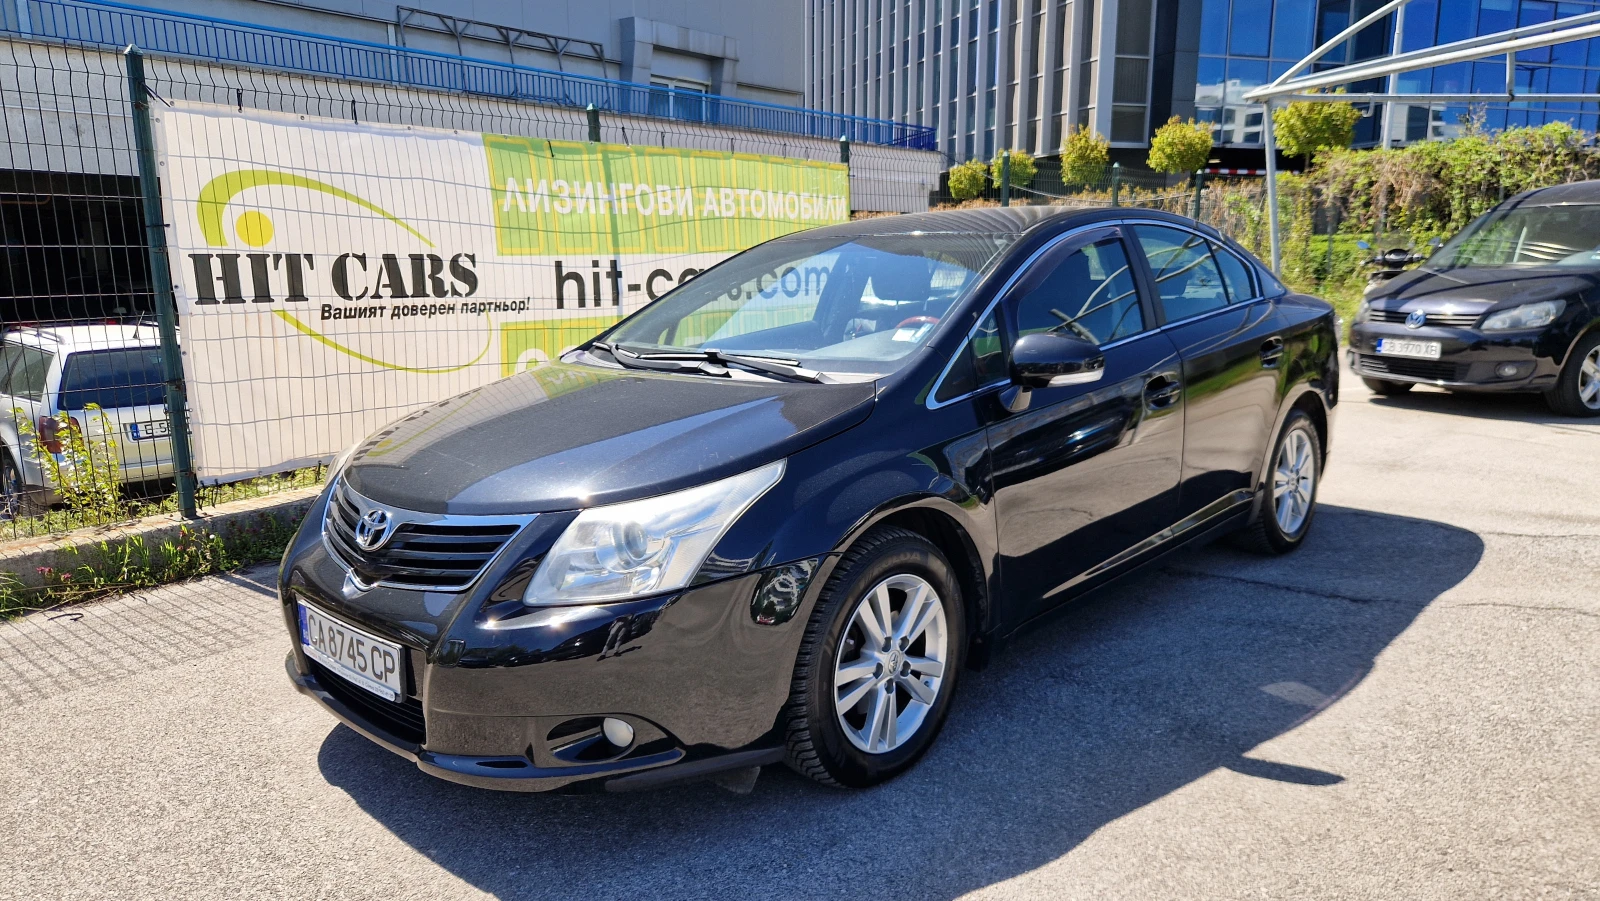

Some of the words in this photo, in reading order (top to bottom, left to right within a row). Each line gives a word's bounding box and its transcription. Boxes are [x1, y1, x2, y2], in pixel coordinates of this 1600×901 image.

[503, 177, 693, 217] ЛИЗИНГОВИ
[703, 186, 847, 221] АВТОМОБИЛИ
[188, 253, 314, 305] HIT
[331, 252, 479, 302] CARS
[320, 303, 387, 320] Вашият
[391, 301, 456, 320] доверен
[460, 296, 531, 316] партньор!
